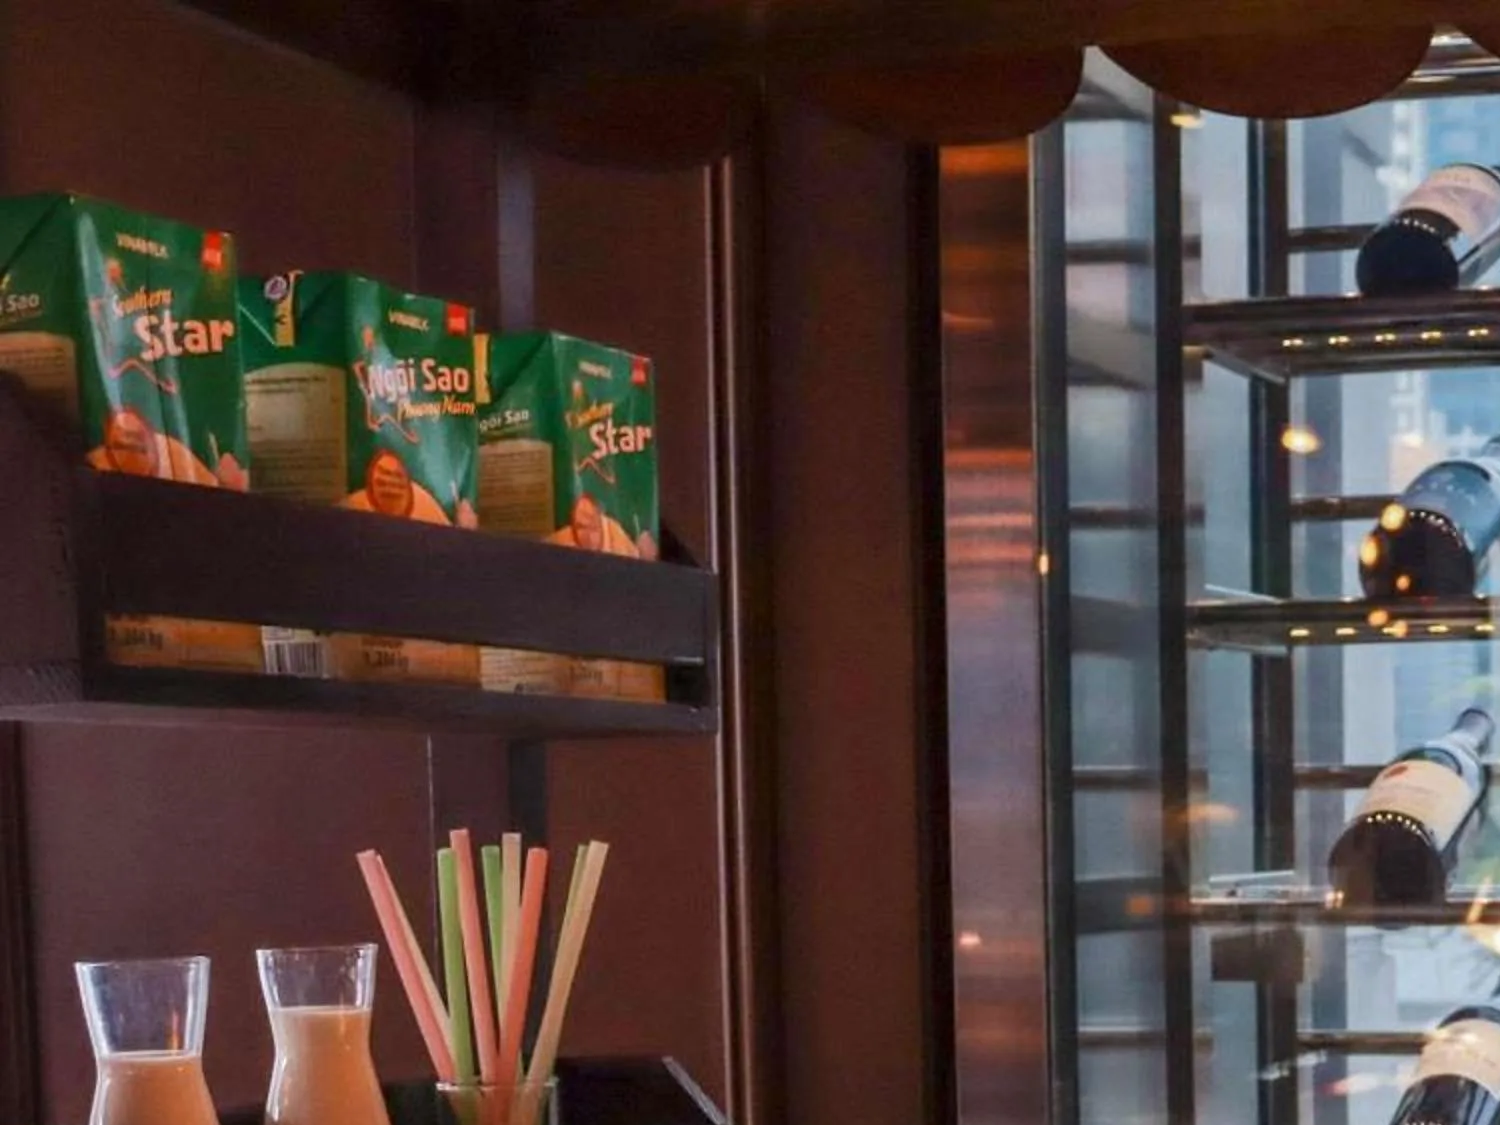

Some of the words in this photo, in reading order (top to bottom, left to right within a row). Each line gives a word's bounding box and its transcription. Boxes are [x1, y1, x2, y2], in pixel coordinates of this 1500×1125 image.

[134, 309, 234, 362] Star
[421, 357, 469, 393] Sao
[589, 418, 651, 459] Star
